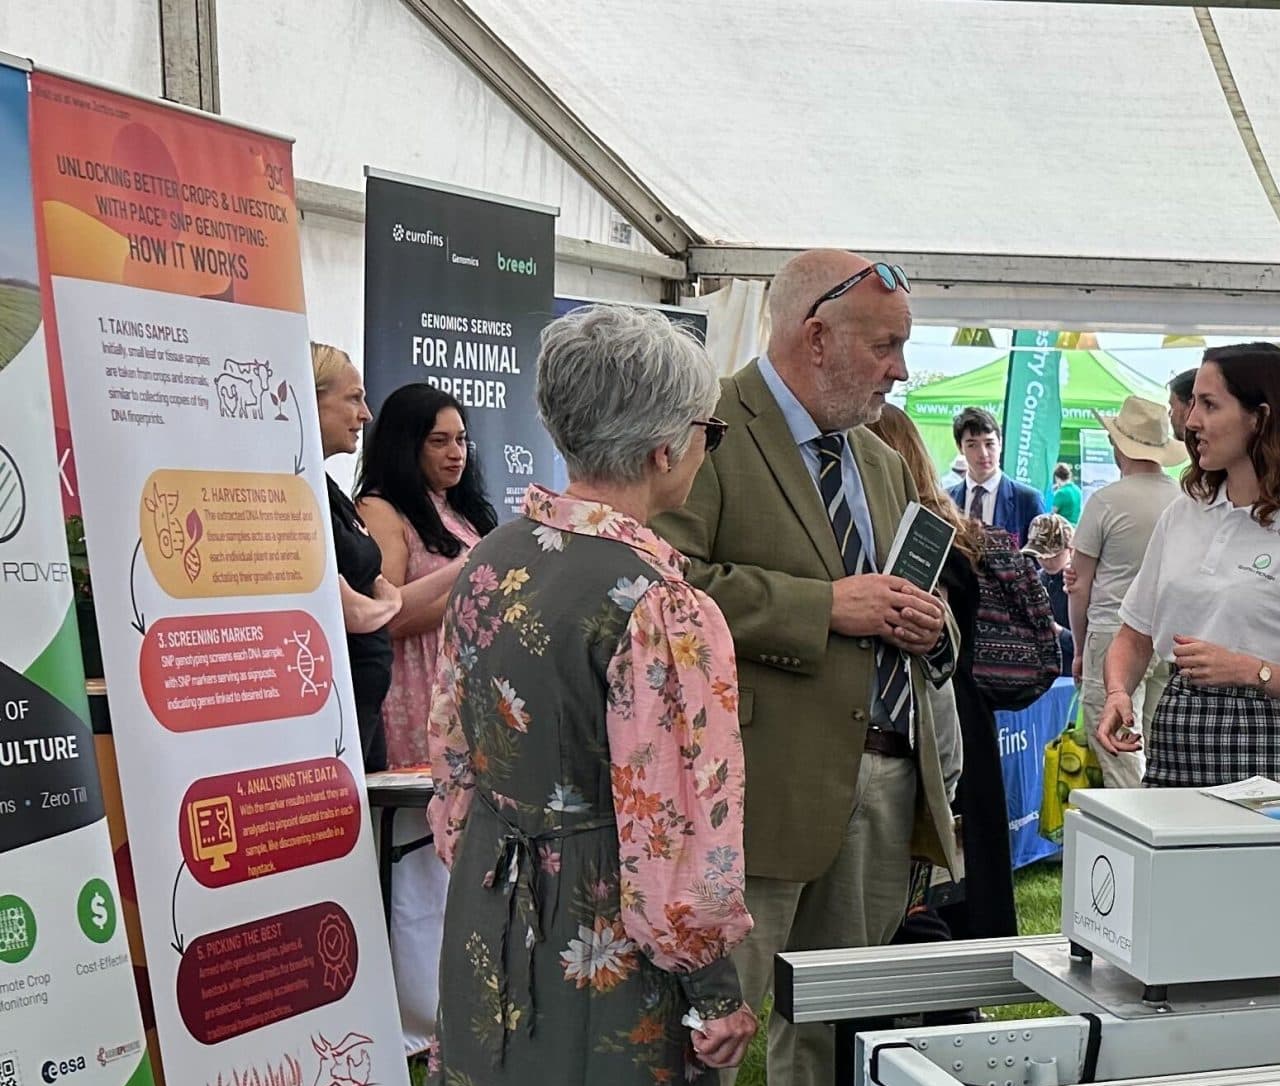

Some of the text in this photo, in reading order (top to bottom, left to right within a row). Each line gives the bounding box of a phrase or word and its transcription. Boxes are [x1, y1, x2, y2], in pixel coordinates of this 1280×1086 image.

[57, 155, 288, 223] UNLOCKING BETTER CROPS & LIVESTOCK
[96, 196, 127, 219] WITH
[170, 214, 192, 233] SNP
[195, 219, 269, 248] GENOTYPING:
[405, 230, 444, 247] eurofins
[128, 233, 248, 280] HOW IT WORKS
[452, 253, 479, 267] Genomics
[98, 317, 189, 344] 1. TAKING SAMPLES
[421, 312, 512, 337] GENOMICS SERVICES
[413, 336, 521, 375] FOR ANIMAL
[201, 487, 287, 504] 2. HARVESTING DNA
[2, 561, 70, 582] ROVER
[157, 625, 264, 648] 3. SCREENING MARKERS
[5, 700, 29, 720] OF
[237, 766, 338, 796] 4. ANALYSING THE DATA
[40, 791, 70, 809] Zero
[206, 935, 241, 957] PICKING
[242, 928, 259, 946] THE
[261, 922, 282, 942] BEST
[1074, 911, 1131, 951] EARTH ROVER
[27, 973, 51, 989] Crop
[59, 1056, 86, 1076] esa
